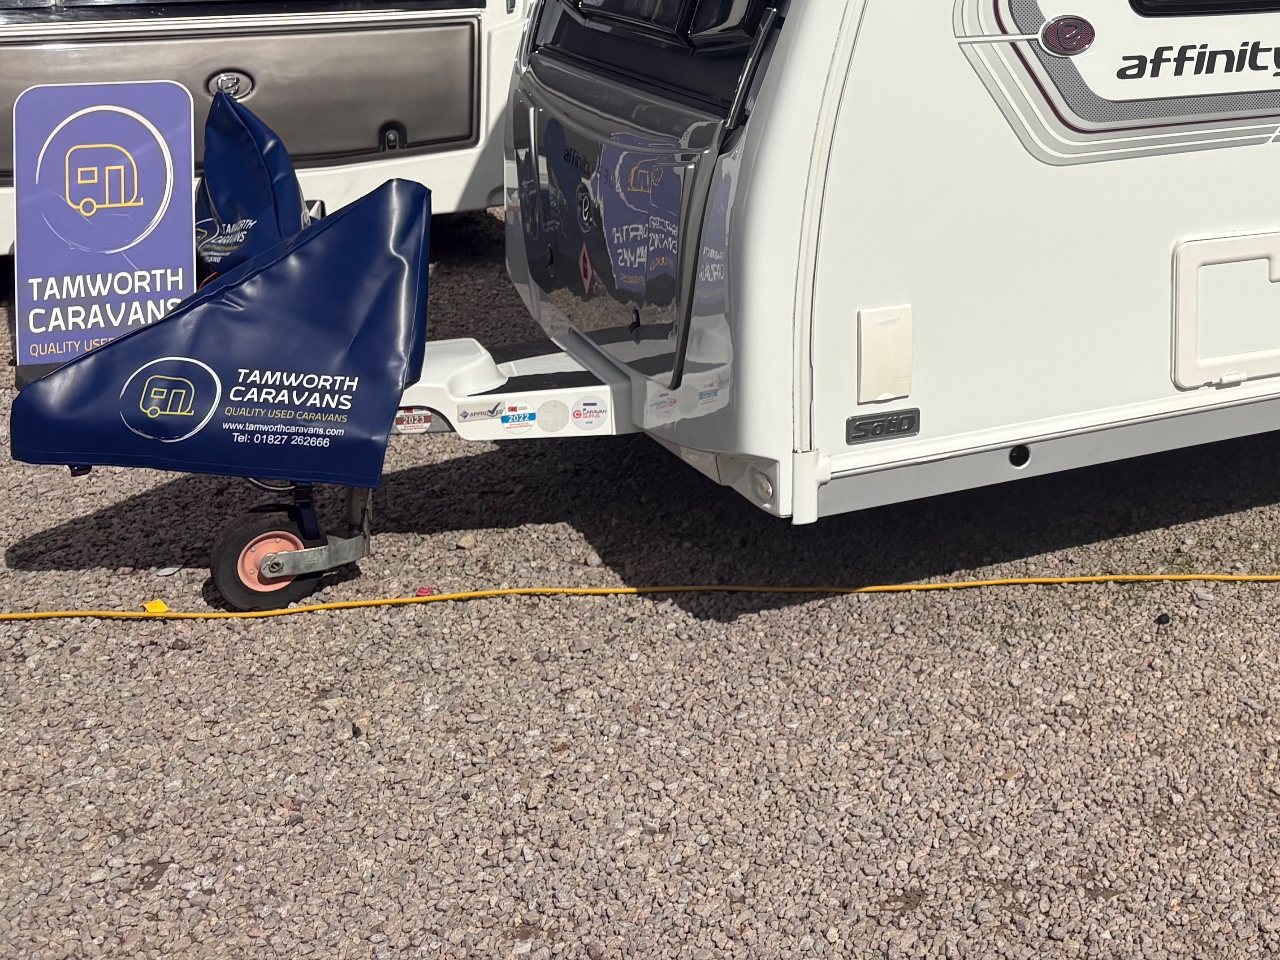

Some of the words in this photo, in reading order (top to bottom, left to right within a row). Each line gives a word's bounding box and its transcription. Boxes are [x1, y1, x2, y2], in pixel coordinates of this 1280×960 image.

[28, 268, 183, 301] TAMWORTH
[30, 340, 81, 357] QUALITY
[237, 368, 359, 392] TAMWORTH
[229, 386, 353, 410] CARAVANS
[224, 406, 266, 417] QUALITY
[268, 409, 294, 419] USED
[296, 411, 348, 423] CARAVANS
[403, 415, 425, 424] 2023
[508, 413, 530, 423] 2022
[222, 422, 345, 436] www.tamworthcaravans.com
[232, 433, 251, 443] Tel:
[254, 434, 288, 445] 01827
[291, 435, 330, 448] 262666
